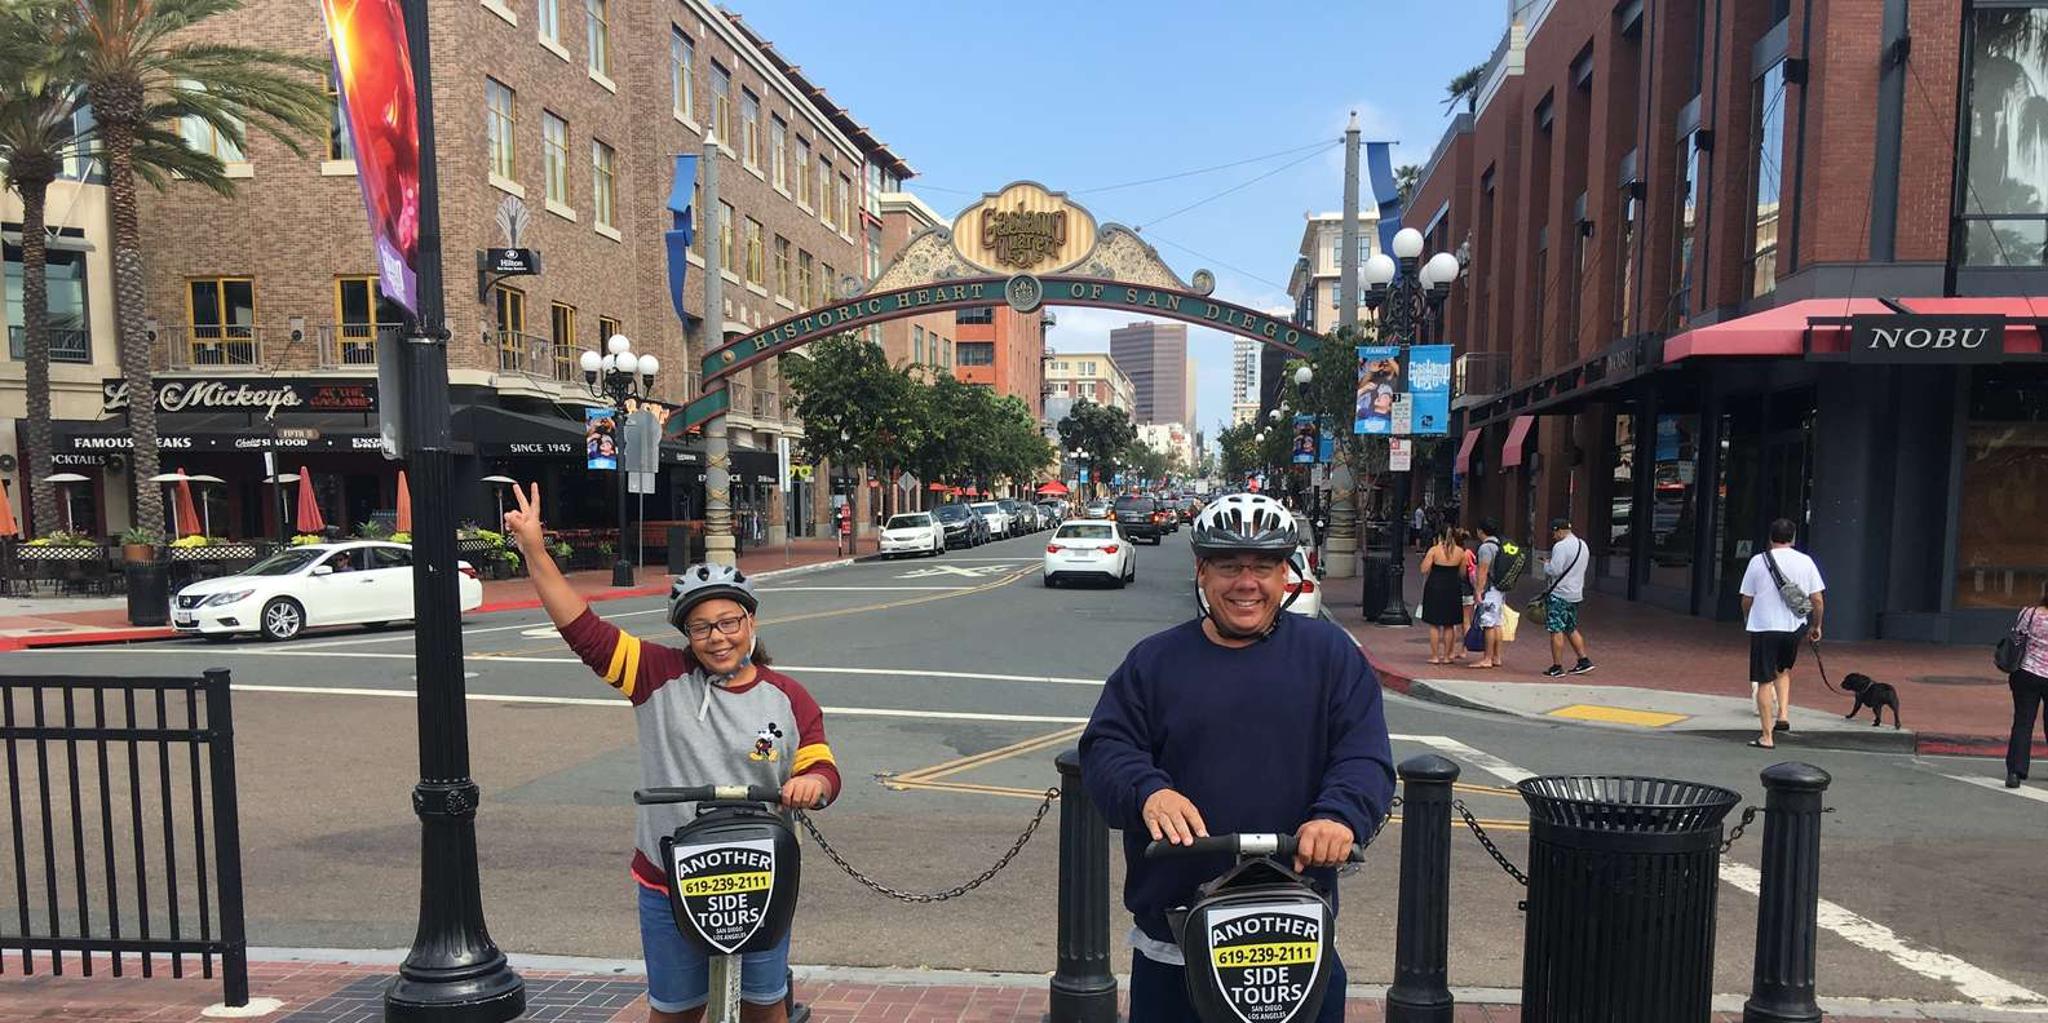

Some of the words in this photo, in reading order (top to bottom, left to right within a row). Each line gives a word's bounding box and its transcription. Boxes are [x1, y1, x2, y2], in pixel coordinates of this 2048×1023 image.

[500, 259, 524, 267] Hilton
[753, 298, 882, 351] HISTORIC
[897, 284, 984, 309] HEART
[1071, 282, 1104, 299] OF
[1126, 288, 1182, 310] SAN
[1205, 304, 1300, 345] DIEGO
[1869, 328, 1989, 349] NOBU
[160, 381, 303, 422] Mickey's
[74, 437, 135, 449] FAMOUS
[155, 437, 192, 448] EAKS
[510, 443, 544, 453] SINCE
[547, 443, 571, 453] 1945
[680, 850, 771, 879] ANOTHER
[685, 876, 767, 894] 619-239-2111
[708, 893, 748, 912] SIDE
[698, 907, 760, 928] TOURS
[1212, 917, 1318, 946] ANOTHER
[1219, 946, 1312, 964] 619-239-2111
[1243, 966, 1289, 986] SIDE
[1231, 983, 1302, 1004] TOURS
[1260, 1011, 1287, 1020] ANGELES
[1264, 1004, 1283, 1012] DIEGO
